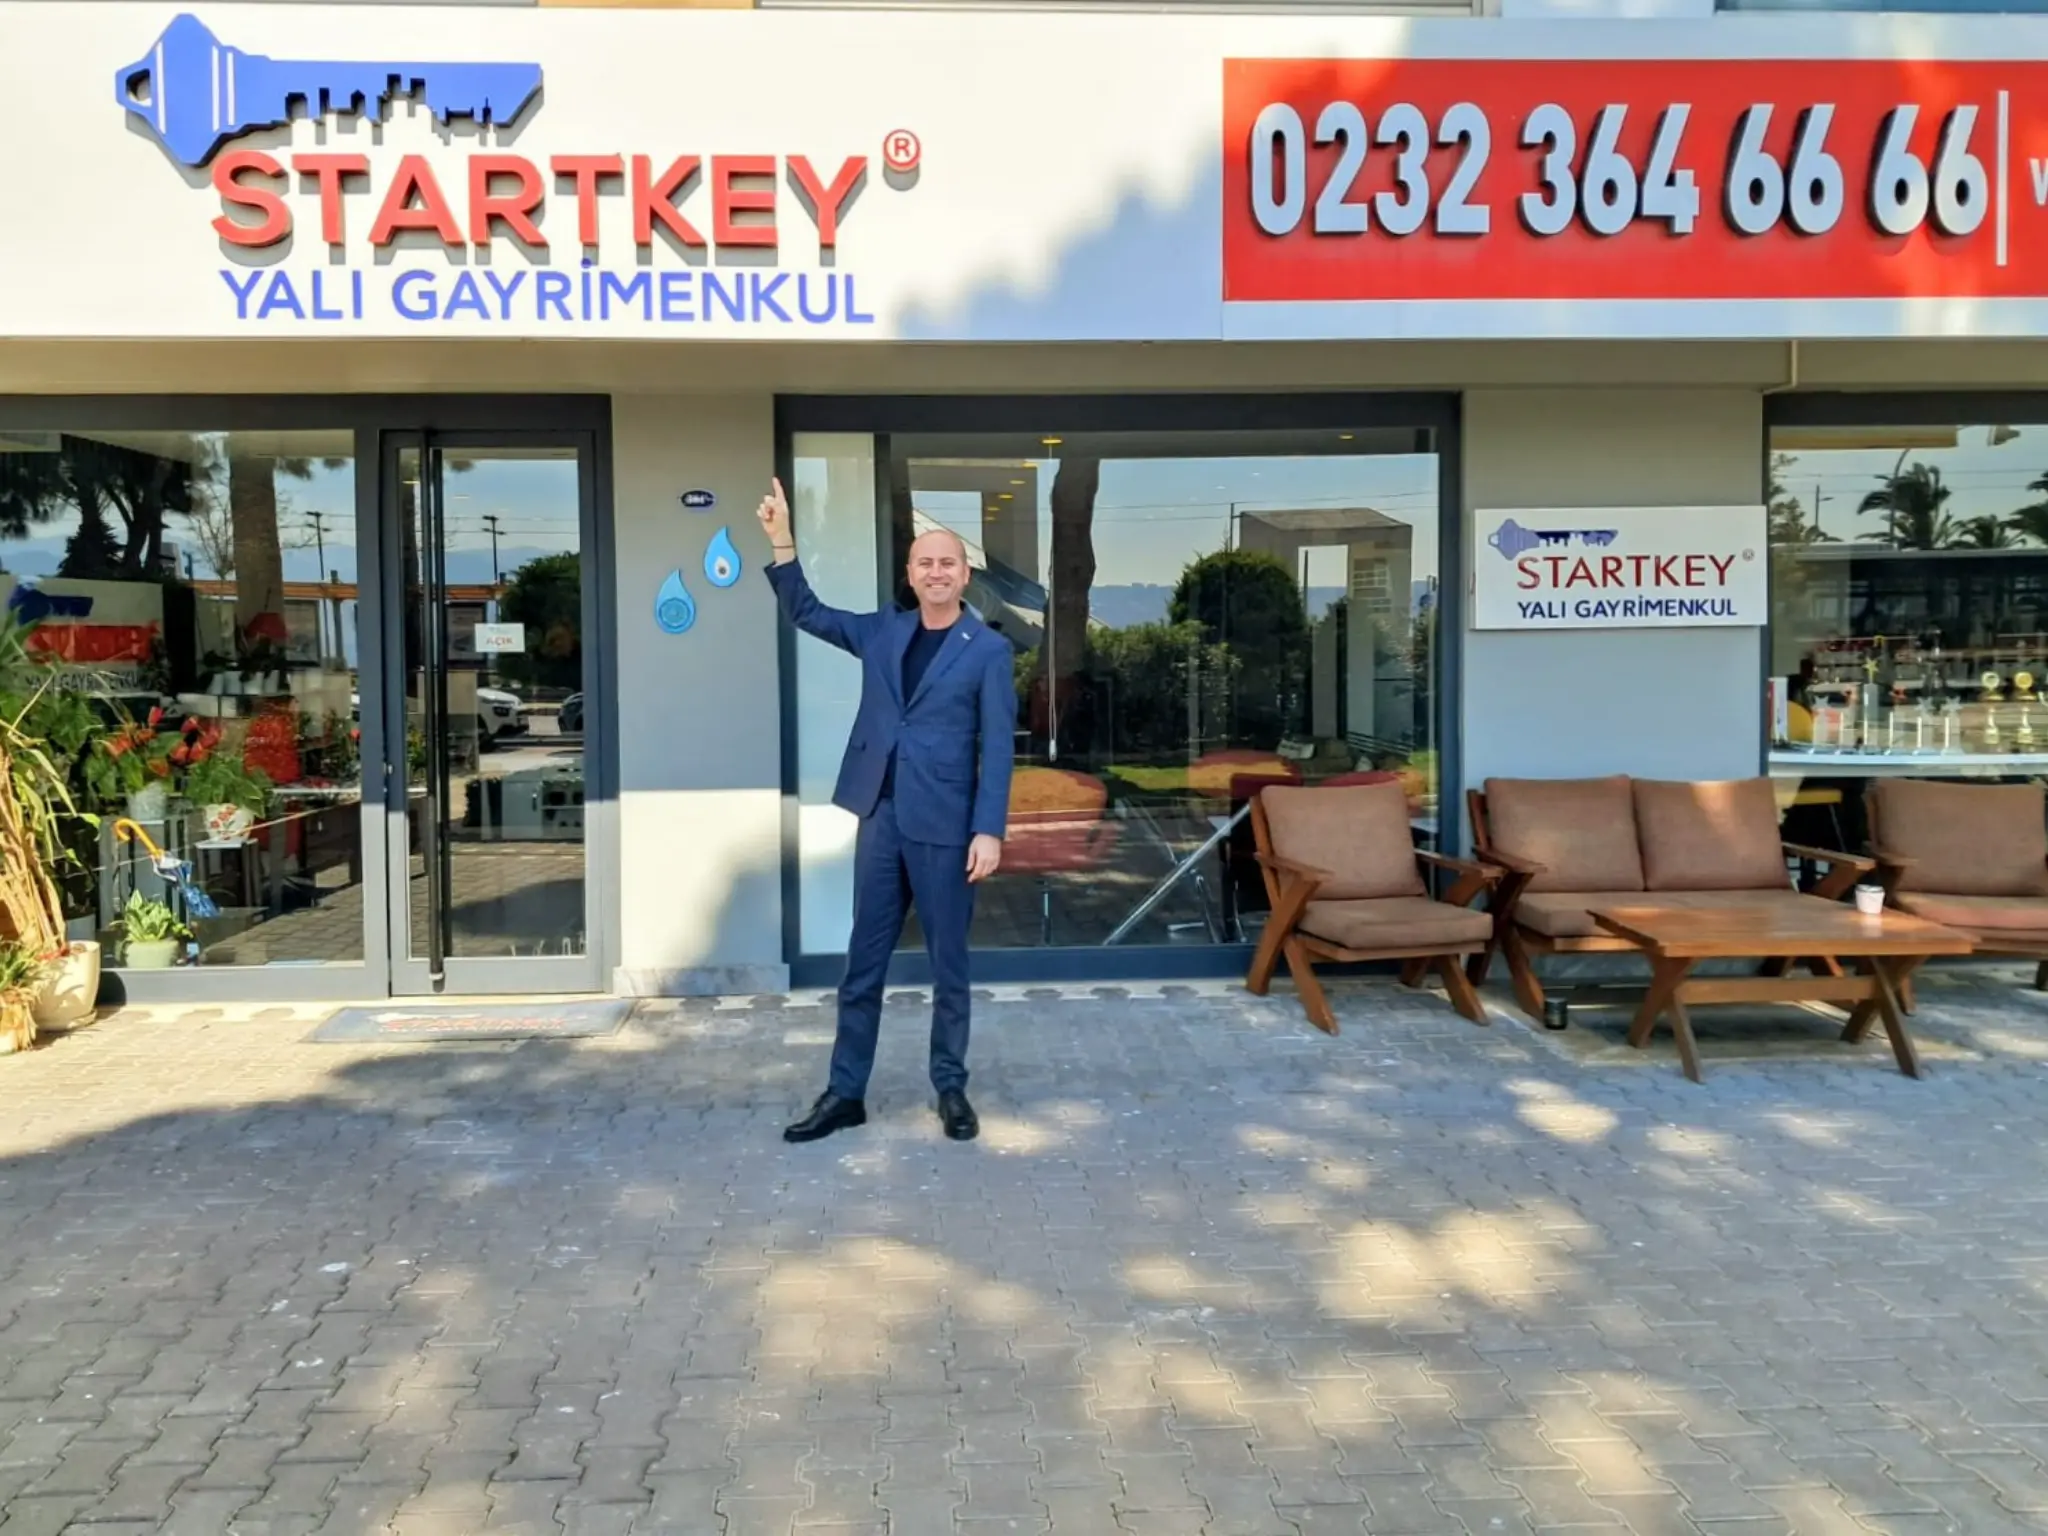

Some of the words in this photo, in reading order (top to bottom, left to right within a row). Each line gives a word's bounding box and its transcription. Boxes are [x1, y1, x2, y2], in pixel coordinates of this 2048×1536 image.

[211, 149, 868, 247] STARTKEY
[1250, 101, 1491, 235] 0232
[1520, 102, 1700, 235] 364
[1728, 102, 1845, 234] 66
[1872, 104, 1989, 235] 66
[219, 269, 362, 321] YALI
[391, 257, 875, 324] GAYRİMENKUL
[1516, 554, 1736, 590] STARTKEY
[1517, 600, 1567, 620] YALI
[1574, 594, 1738, 619] GAYRİMENKUL
